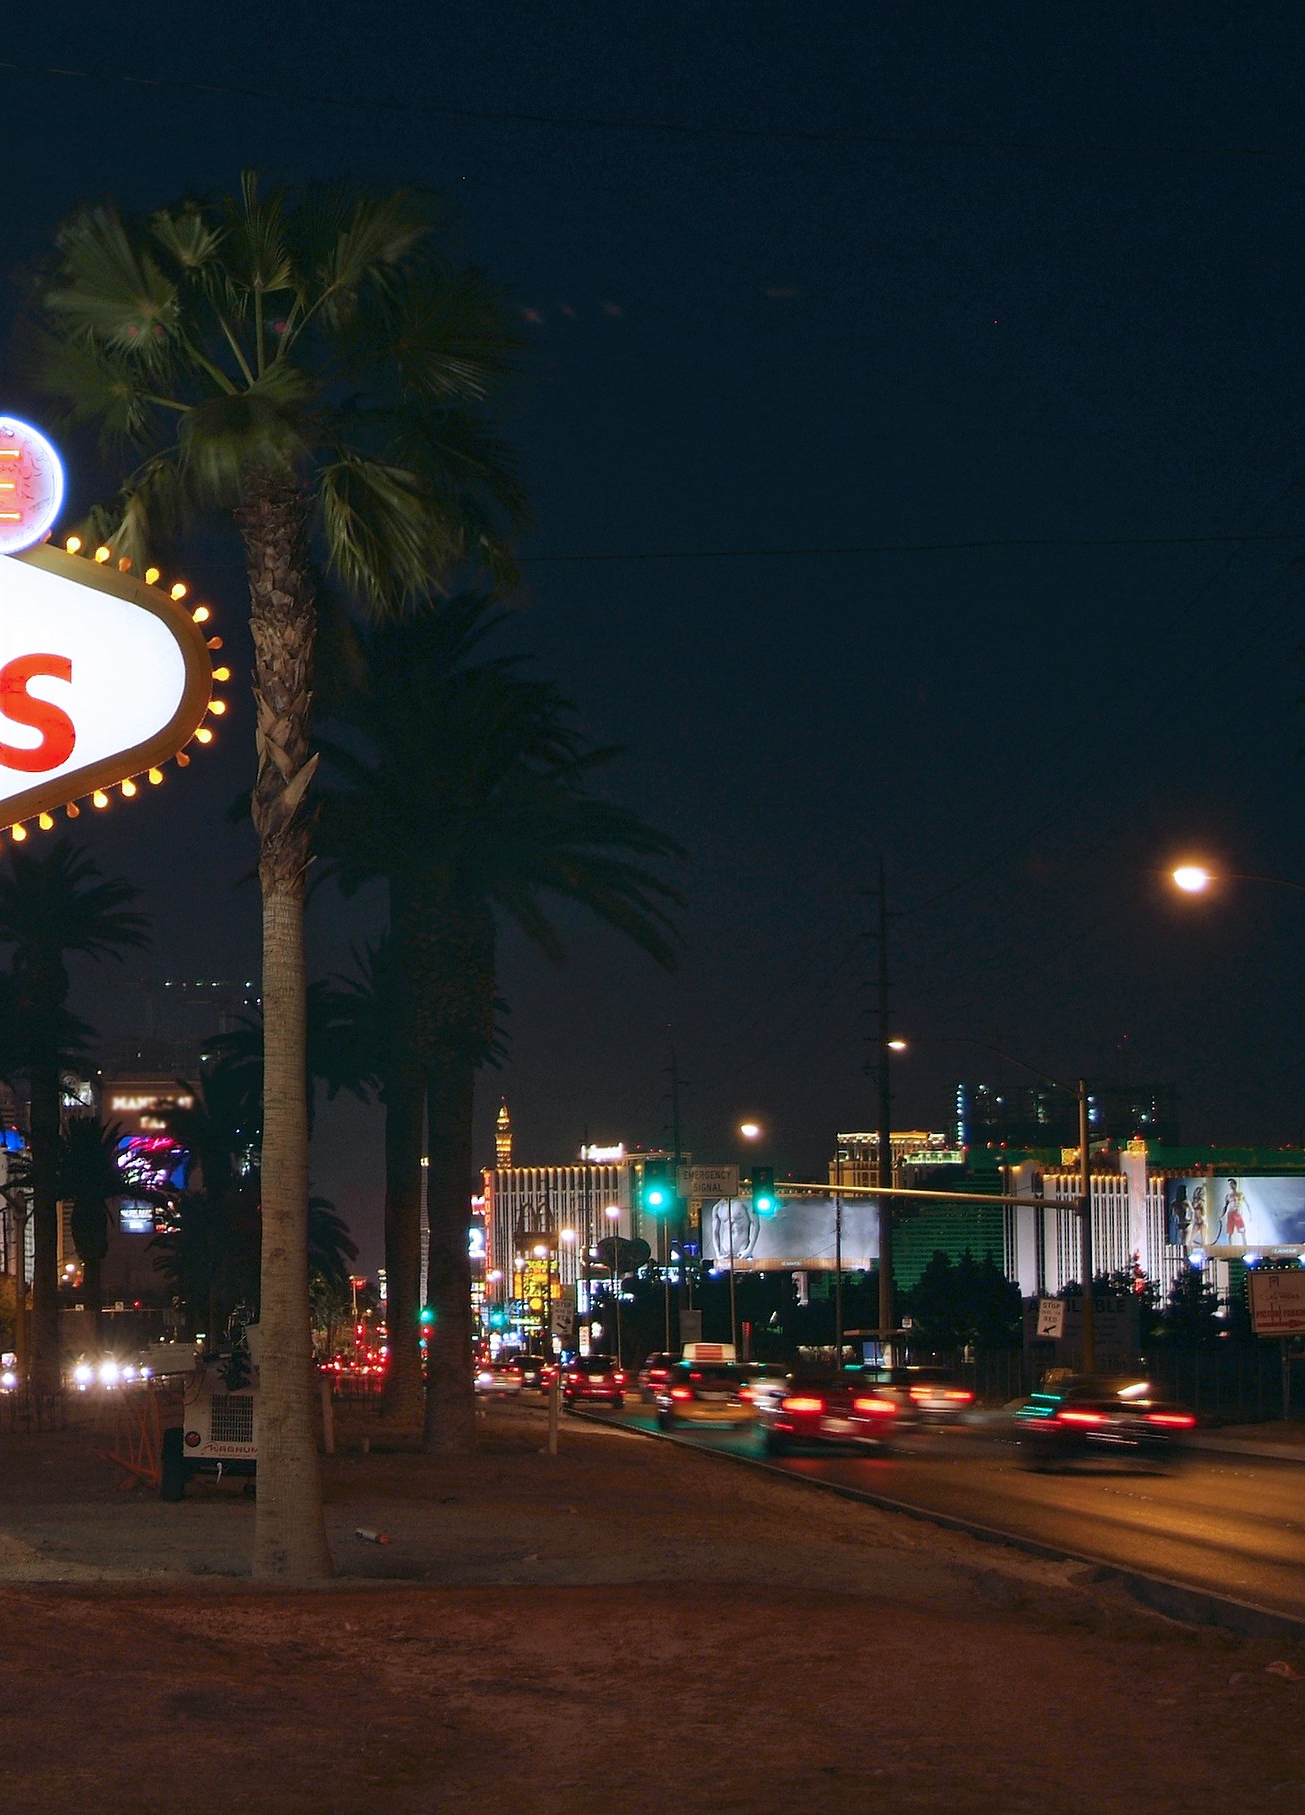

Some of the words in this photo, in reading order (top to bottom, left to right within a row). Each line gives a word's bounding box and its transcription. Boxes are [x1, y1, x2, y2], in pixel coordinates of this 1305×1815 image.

[683, 1170, 732, 1180] EMERGENCY
[693, 1183, 723, 1192] SIGNAL
[1043, 1315, 1058, 1323] RED
